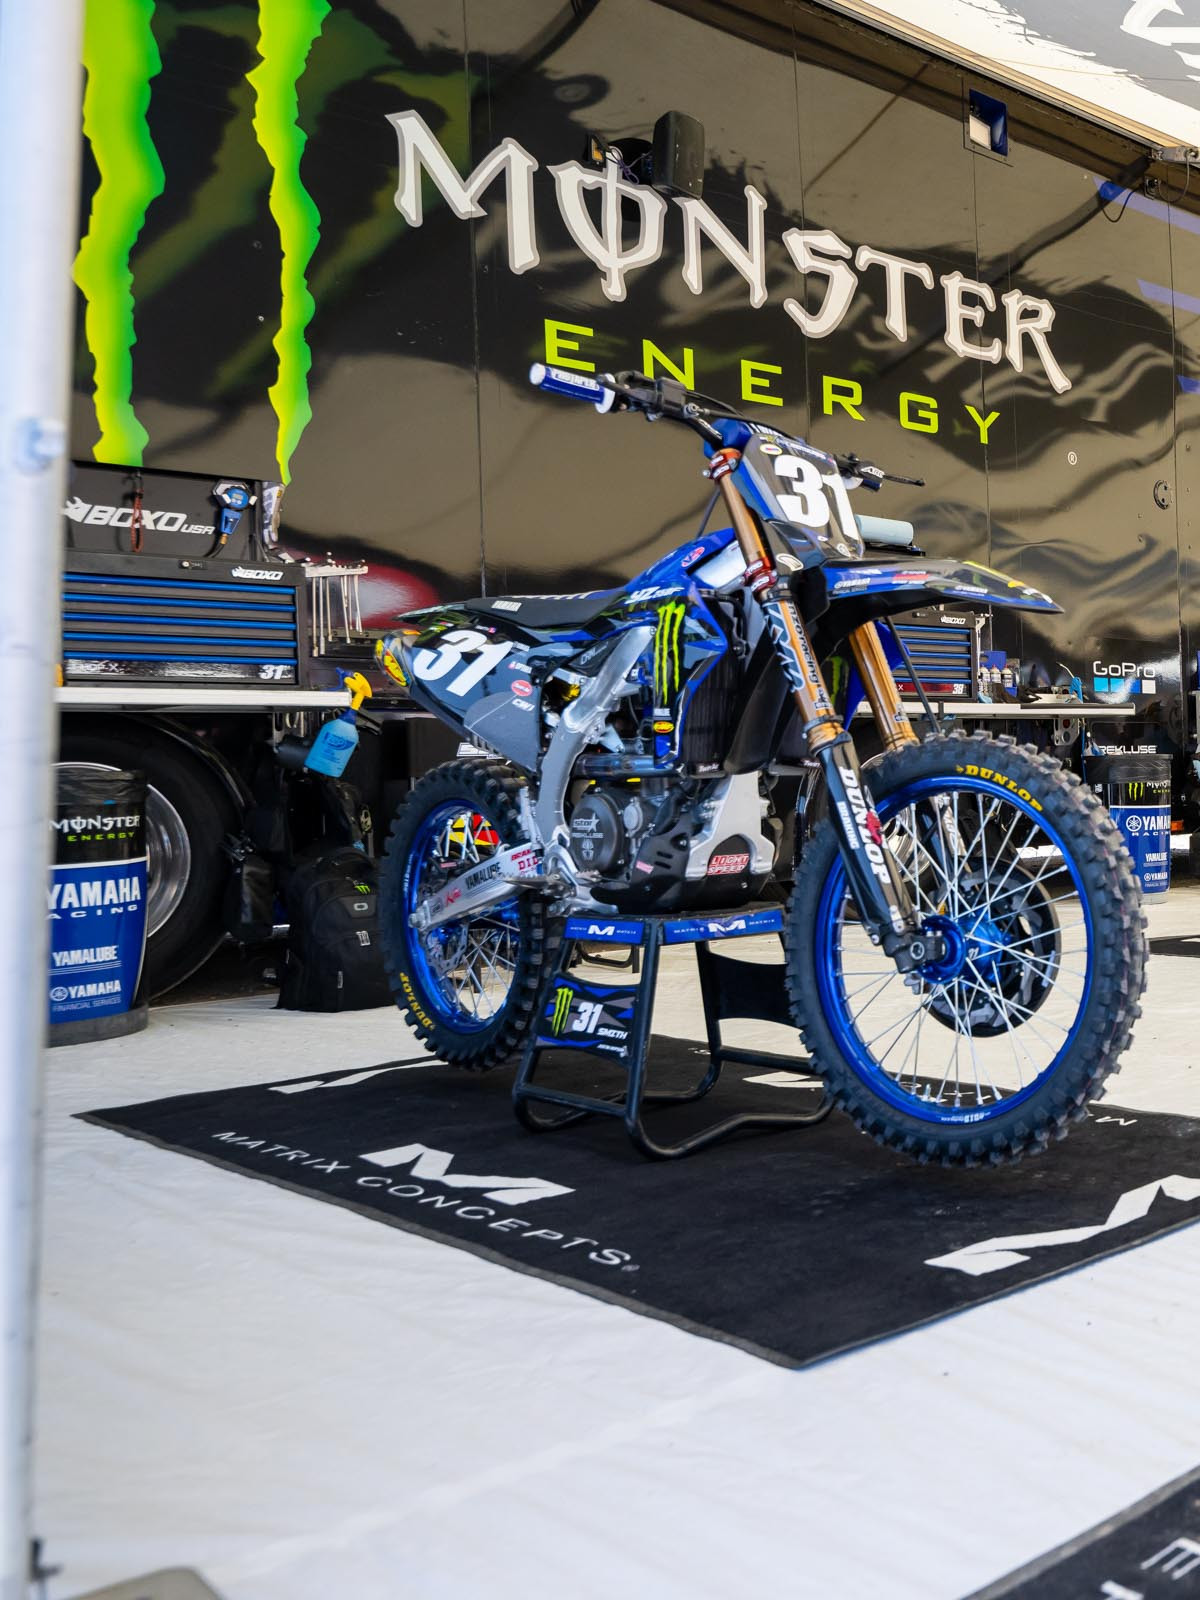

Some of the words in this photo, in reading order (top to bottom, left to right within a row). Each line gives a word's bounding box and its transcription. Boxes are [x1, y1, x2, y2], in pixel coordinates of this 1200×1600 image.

[385, 110, 1072, 394] MONSTER
[544, 318, 1001, 445] ENERGY
[774, 454, 860, 542] 31
[84, 504, 187, 532] BOXO
[413, 629, 514, 697] 31
[1092, 660, 1156, 678] GoPro
[1098, 744, 1158, 755] REKLUSE
[965, 764, 1044, 812] DUNLOP
[67, 832, 135, 842] ENERGY
[838, 765, 891, 884] DUNLOP
[707, 863, 748, 876] SPEED
[711, 853, 750, 867] LIGHT
[47, 904, 138, 921] ACING
[52, 945, 119, 967] YAMALUBE
[68, 979, 122, 999] YAMAHA
[572, 1001, 604, 1033] 31
[597, 1028, 629, 1040] SMITH
[211, 1131, 351, 1174] MATRIX
